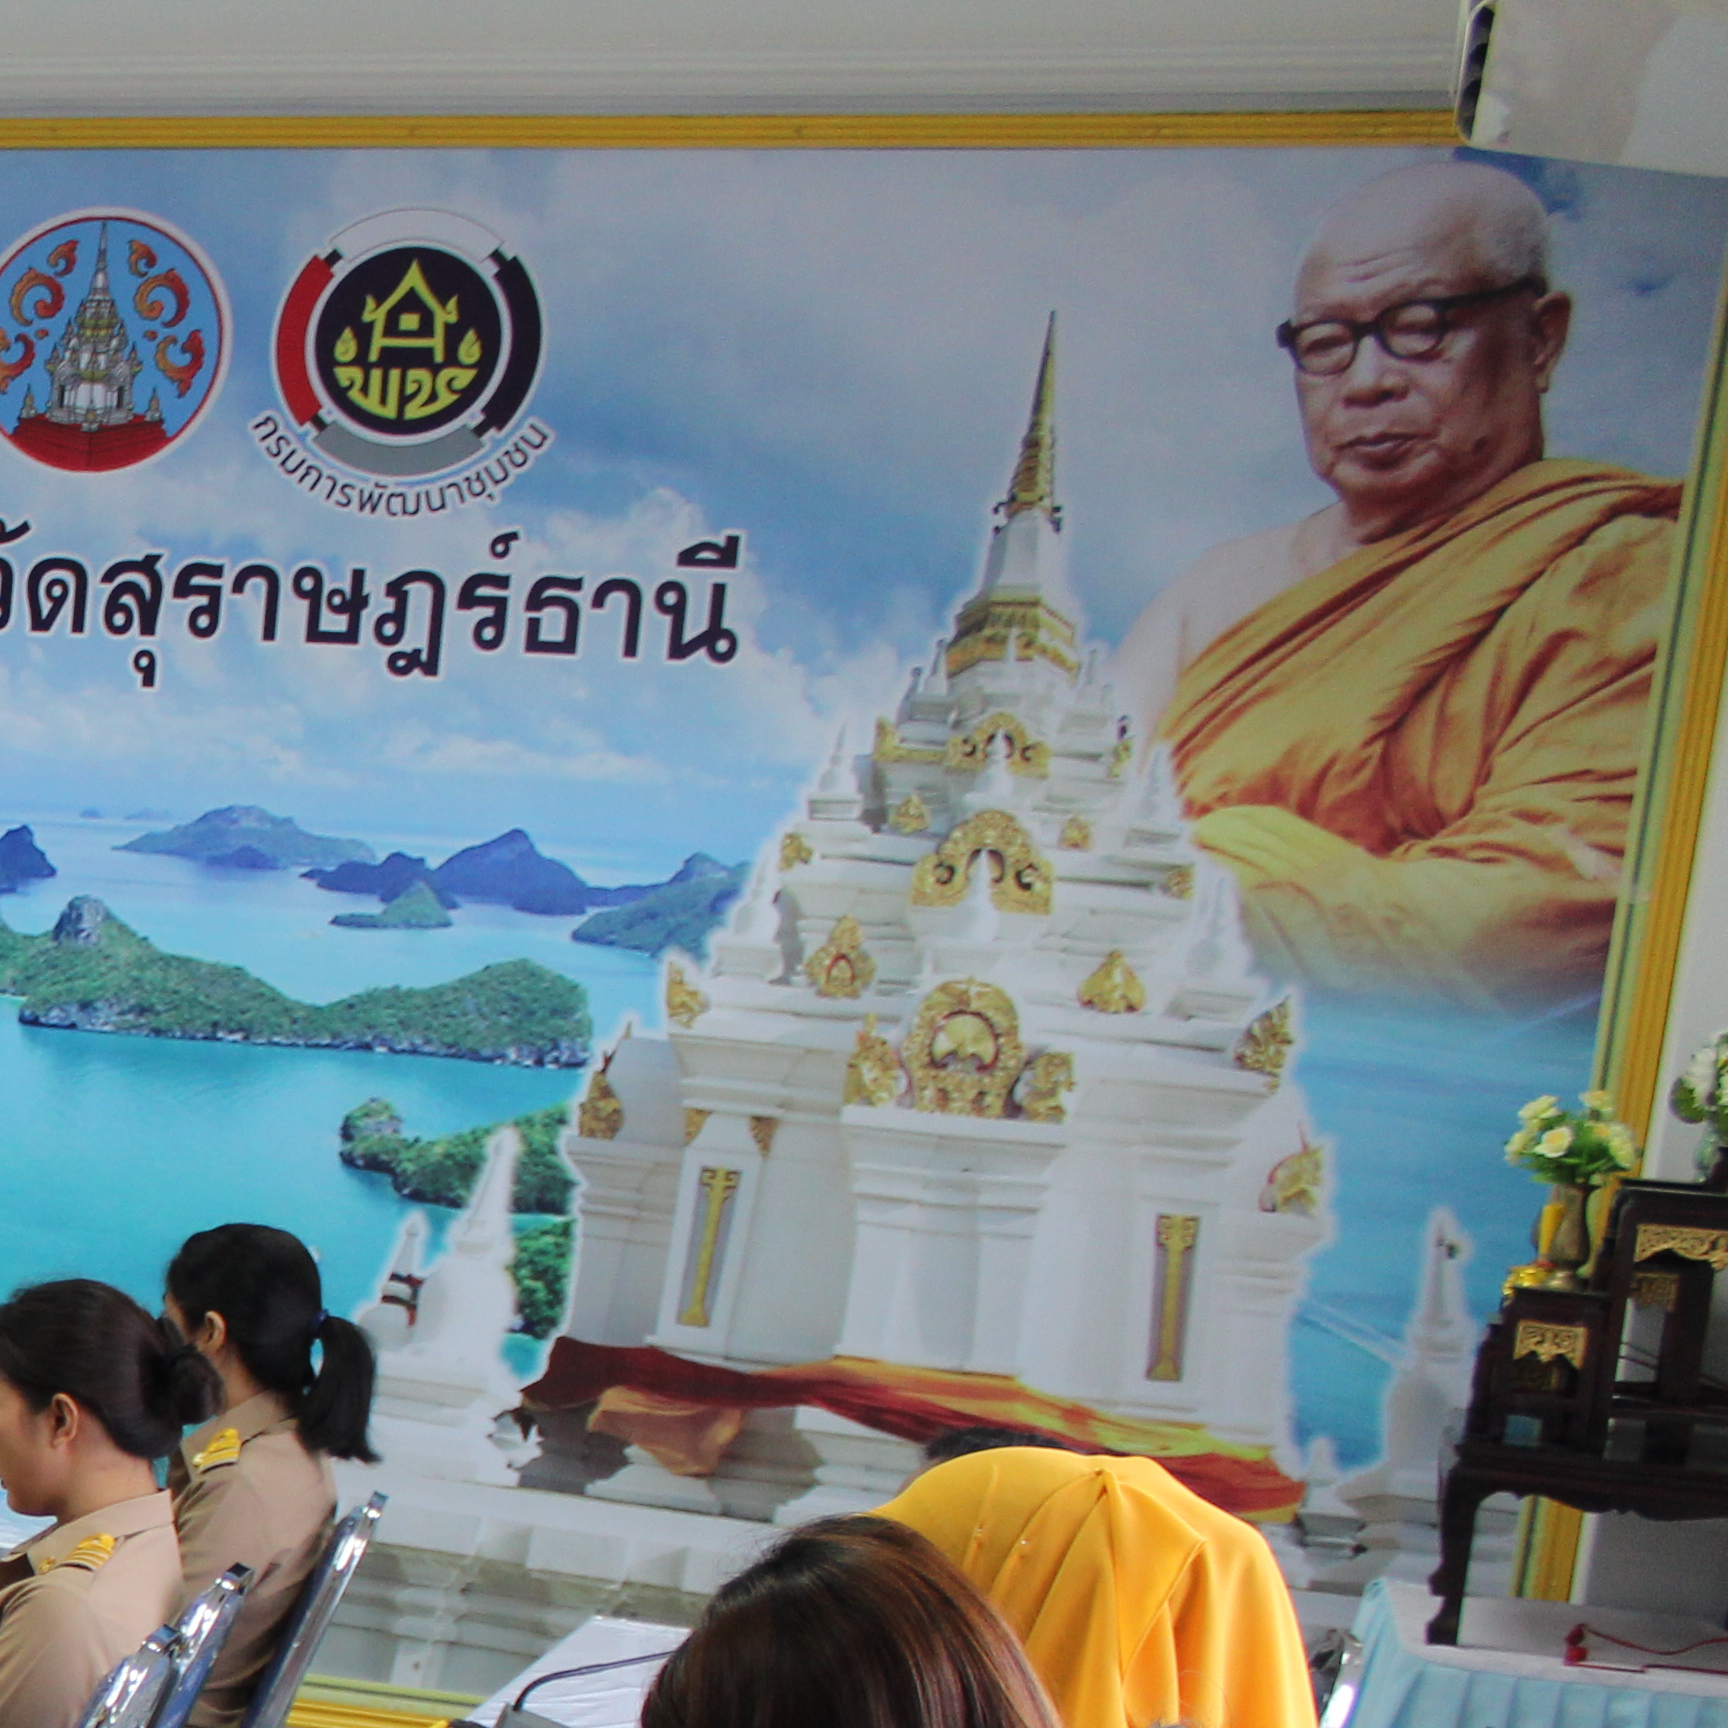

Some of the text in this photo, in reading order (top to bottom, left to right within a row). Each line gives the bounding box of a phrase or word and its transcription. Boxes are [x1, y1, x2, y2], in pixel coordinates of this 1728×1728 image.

[252, 414, 549, 518] กรมการพัฒนาชุมชน
